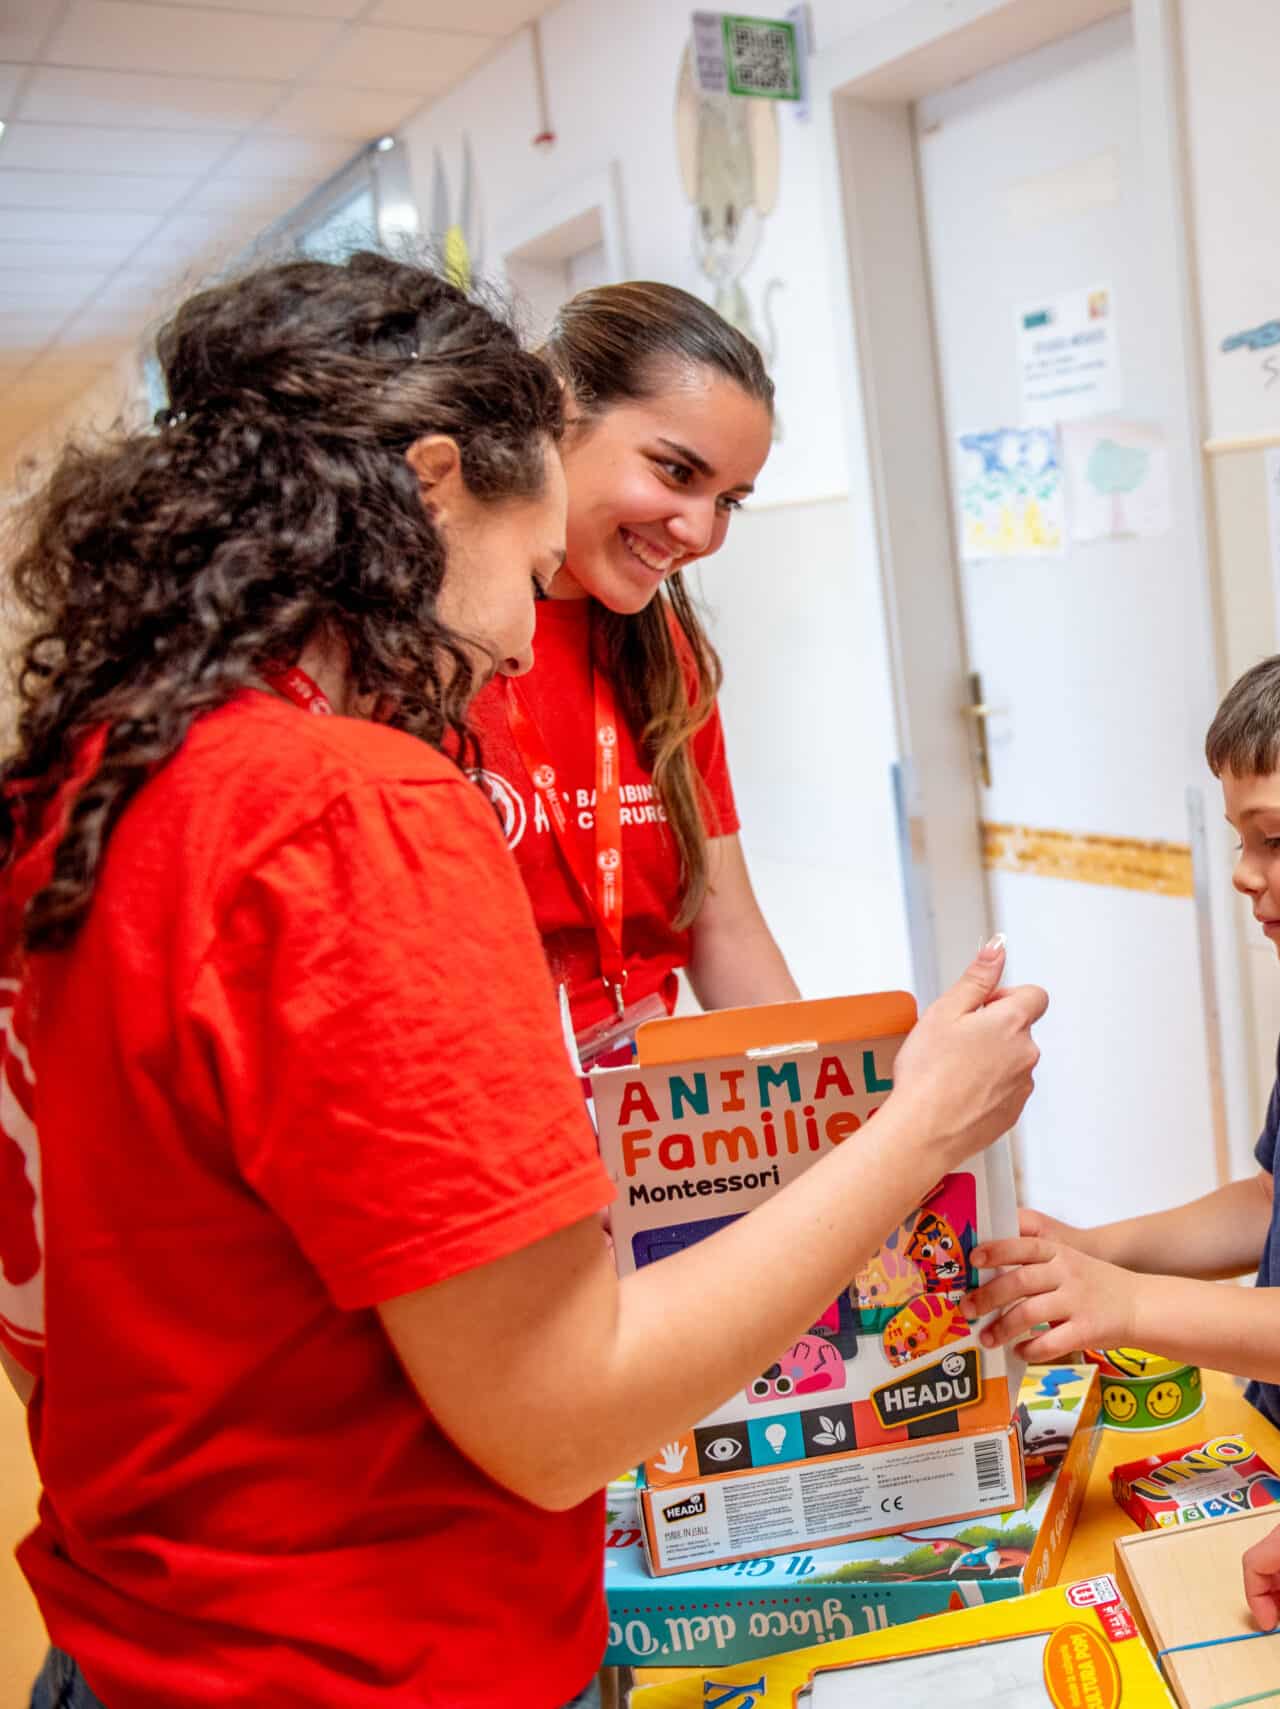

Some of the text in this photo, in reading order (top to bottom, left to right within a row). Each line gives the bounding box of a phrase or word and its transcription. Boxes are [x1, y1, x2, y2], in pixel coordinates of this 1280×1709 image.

[617, 1050, 894, 1126] ANIMAL
[621, 1105, 882, 1177] Familie
[629, 1164, 781, 1207] Montessori
[883, 1376, 971, 1413] HEADU
[1130, 1436, 1256, 1502] UNO
[666, 1502, 704, 1519] HEADU
[607, 1614, 737, 1657] dell'Oc
